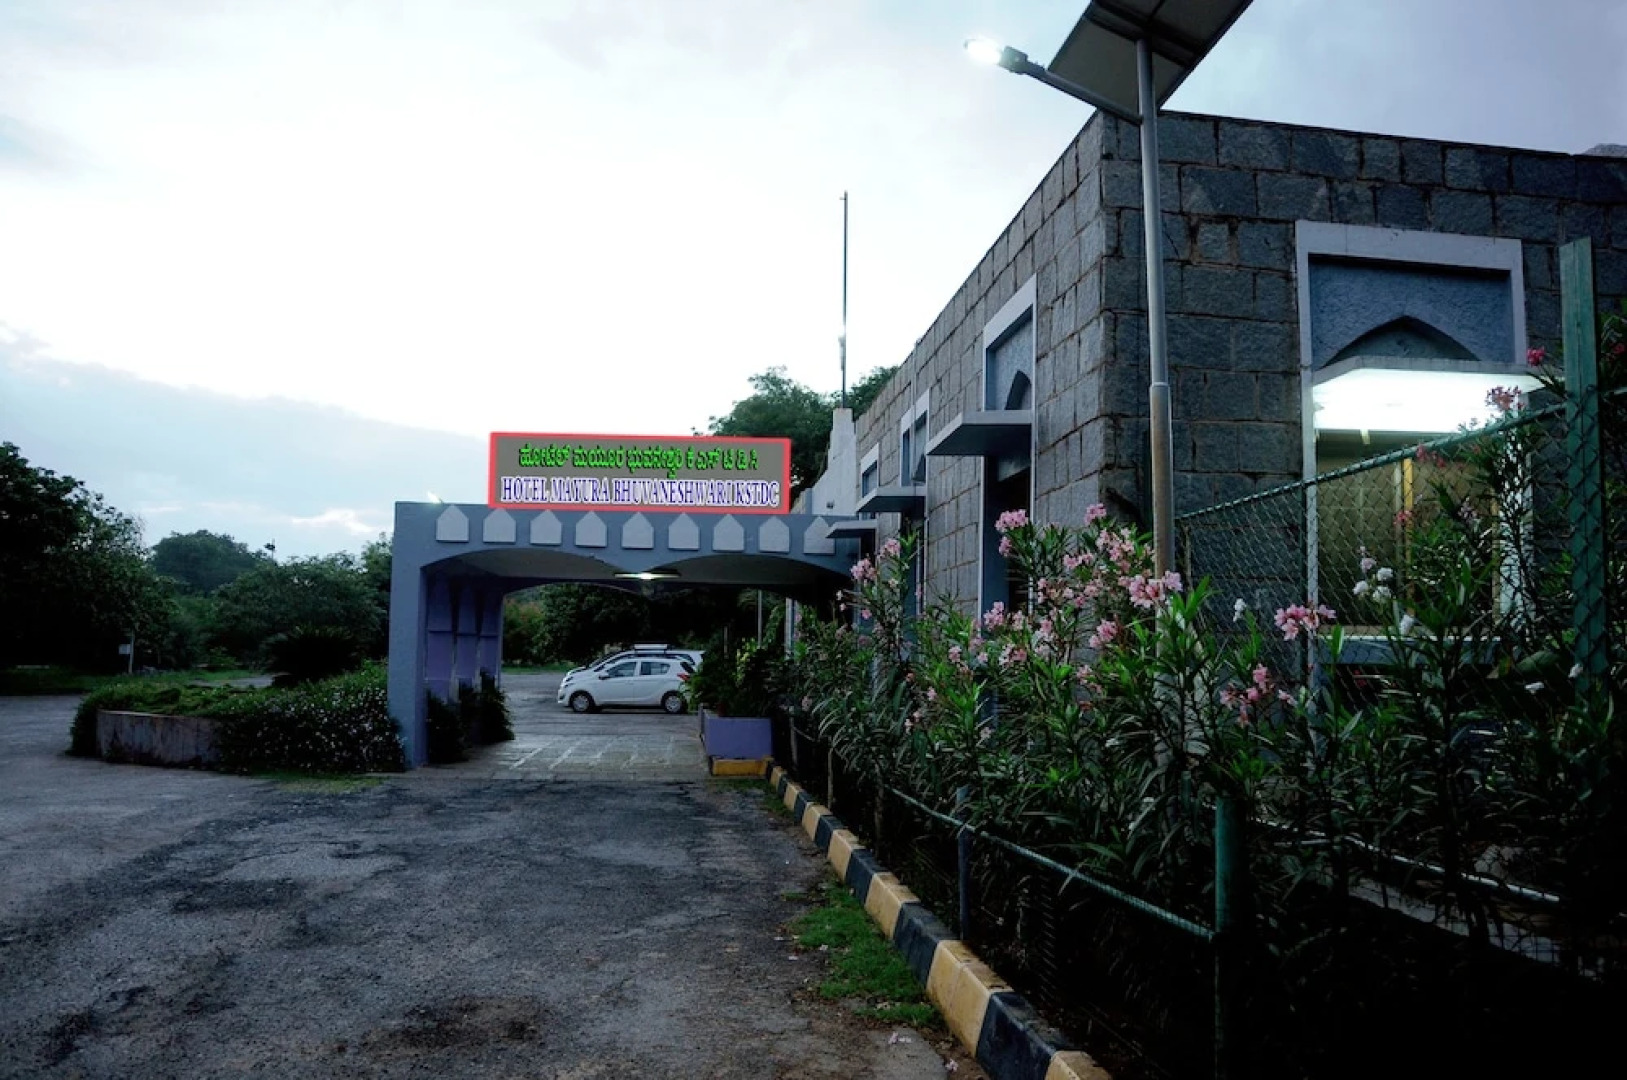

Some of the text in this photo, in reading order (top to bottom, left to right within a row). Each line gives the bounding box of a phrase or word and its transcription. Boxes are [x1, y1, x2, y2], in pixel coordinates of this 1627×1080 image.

[502, 477, 778, 507] HOTEL MAYURA BHUVANESHWARI KSTDC
